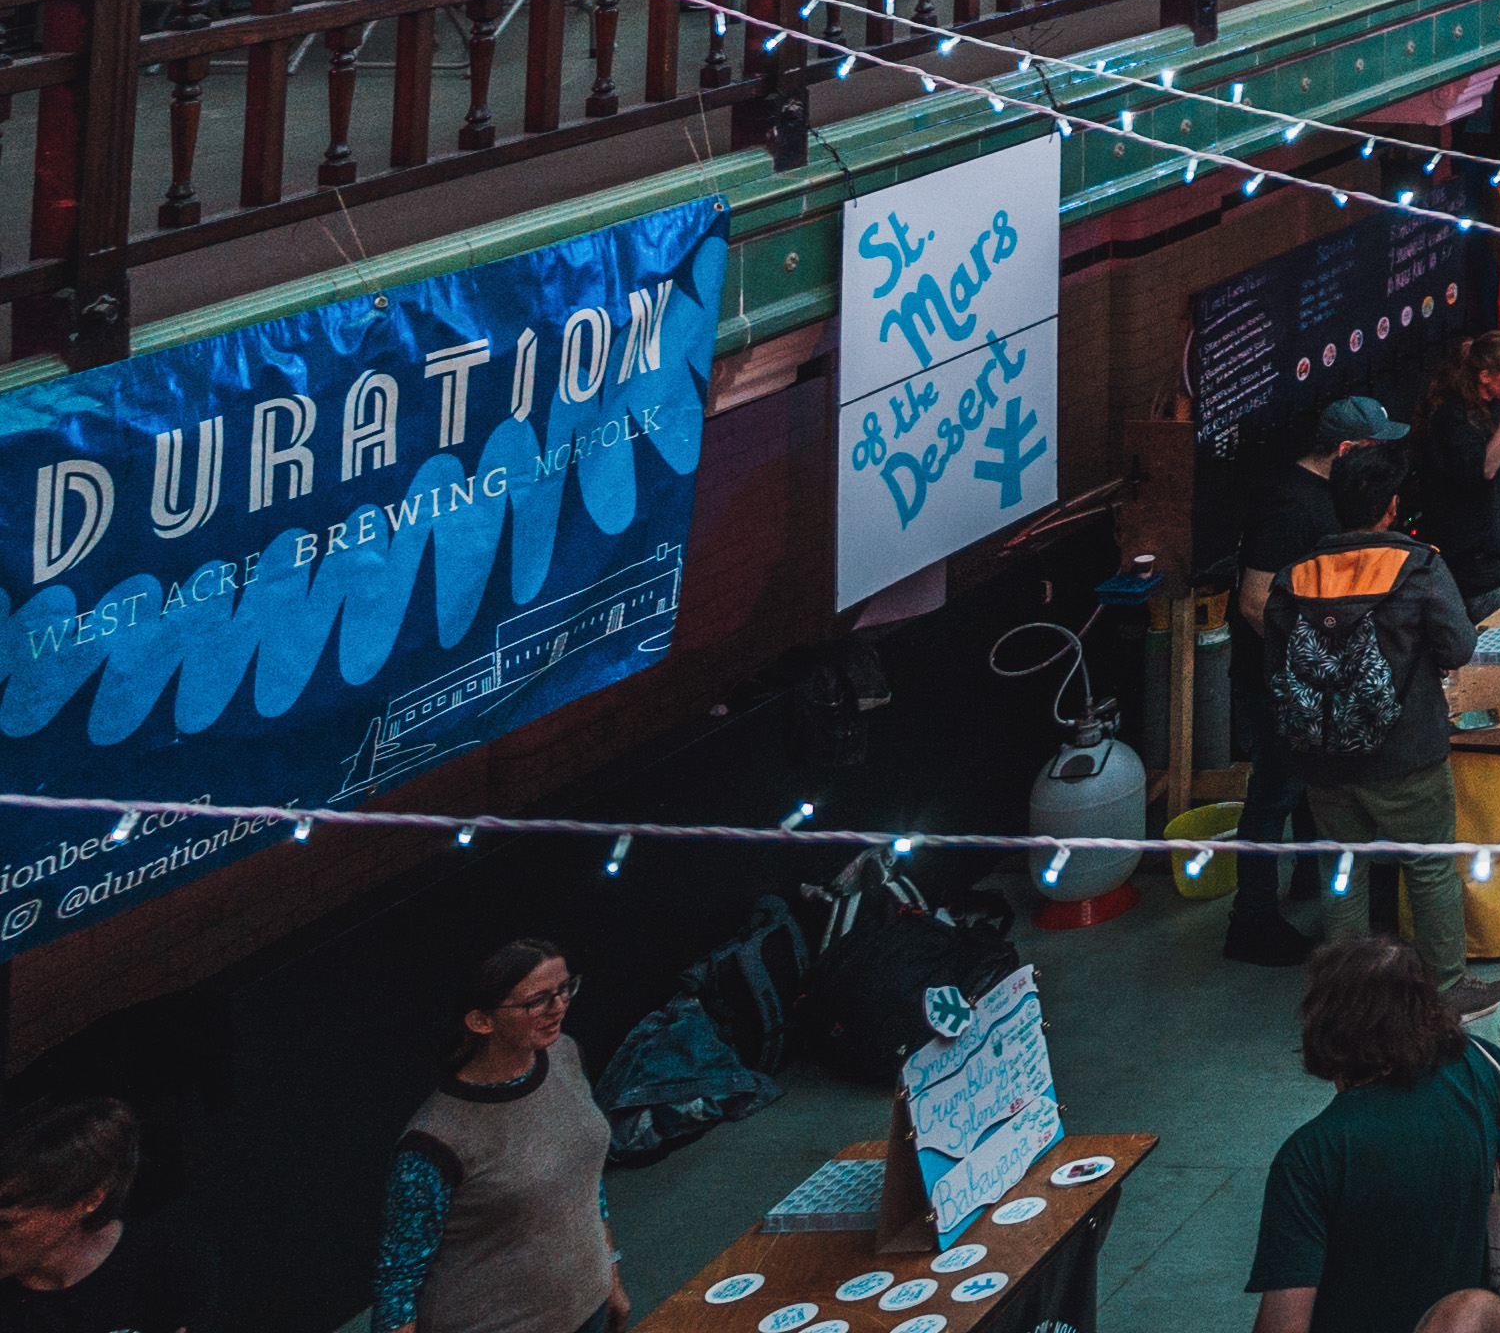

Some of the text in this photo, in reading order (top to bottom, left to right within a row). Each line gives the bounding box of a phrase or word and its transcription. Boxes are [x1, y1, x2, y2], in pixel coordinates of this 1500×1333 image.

[858, 210, 935, 299] St.
[879, 209, 1018, 369] Mars
[31, 278, 676, 585] DURATION
[880, 328, 1027, 531] Desert
[889, 377, 941, 439] the
[26, 403, 663, 662] WEST ACRE BREWING NORFOLK
[57, 798, 300, 921] @durationbeer
[915, 1053, 1010, 1136] Crumbling
[935, 1134, 1033, 1231] Babayaga
